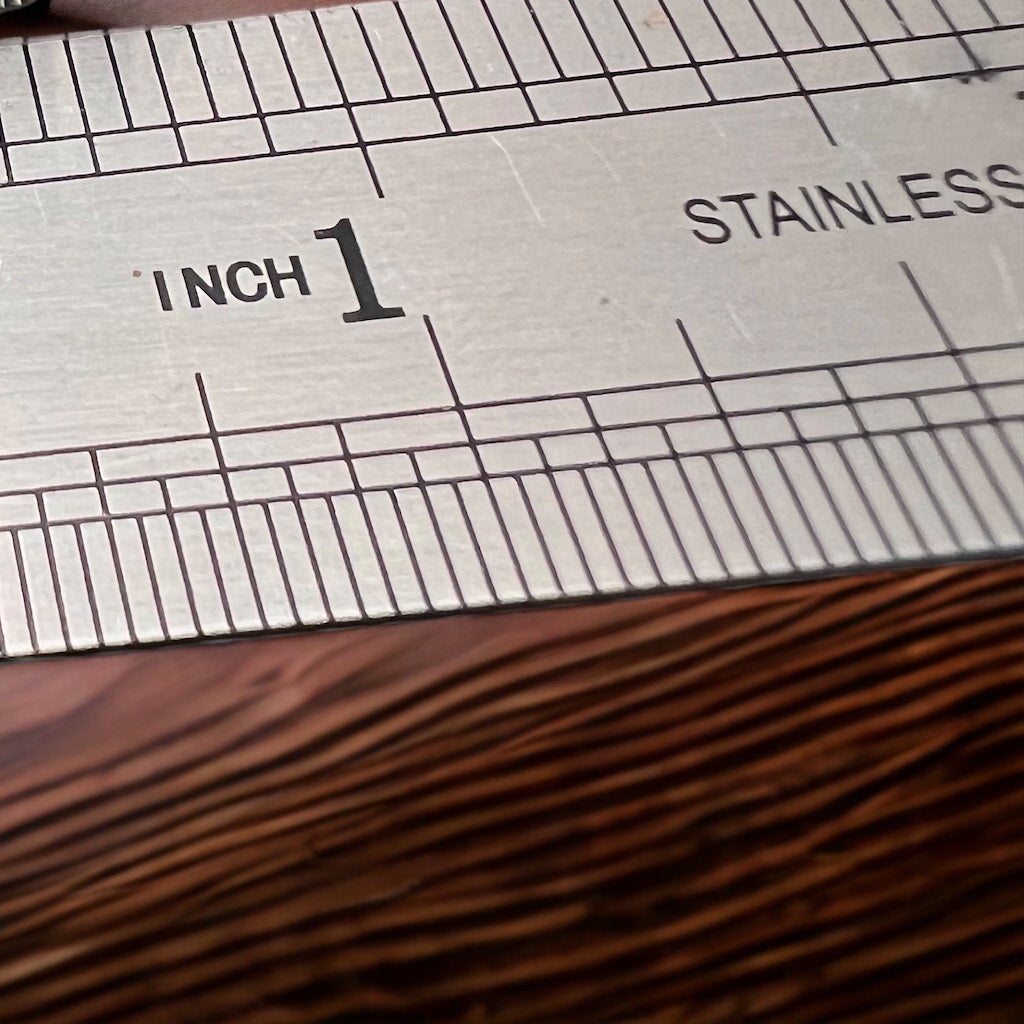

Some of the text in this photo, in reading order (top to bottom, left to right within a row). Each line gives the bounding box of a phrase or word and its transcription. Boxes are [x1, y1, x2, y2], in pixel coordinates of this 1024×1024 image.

[684, 163, 1024, 244] STAINLESS
[153, 217, 406, 323] INCH 1
